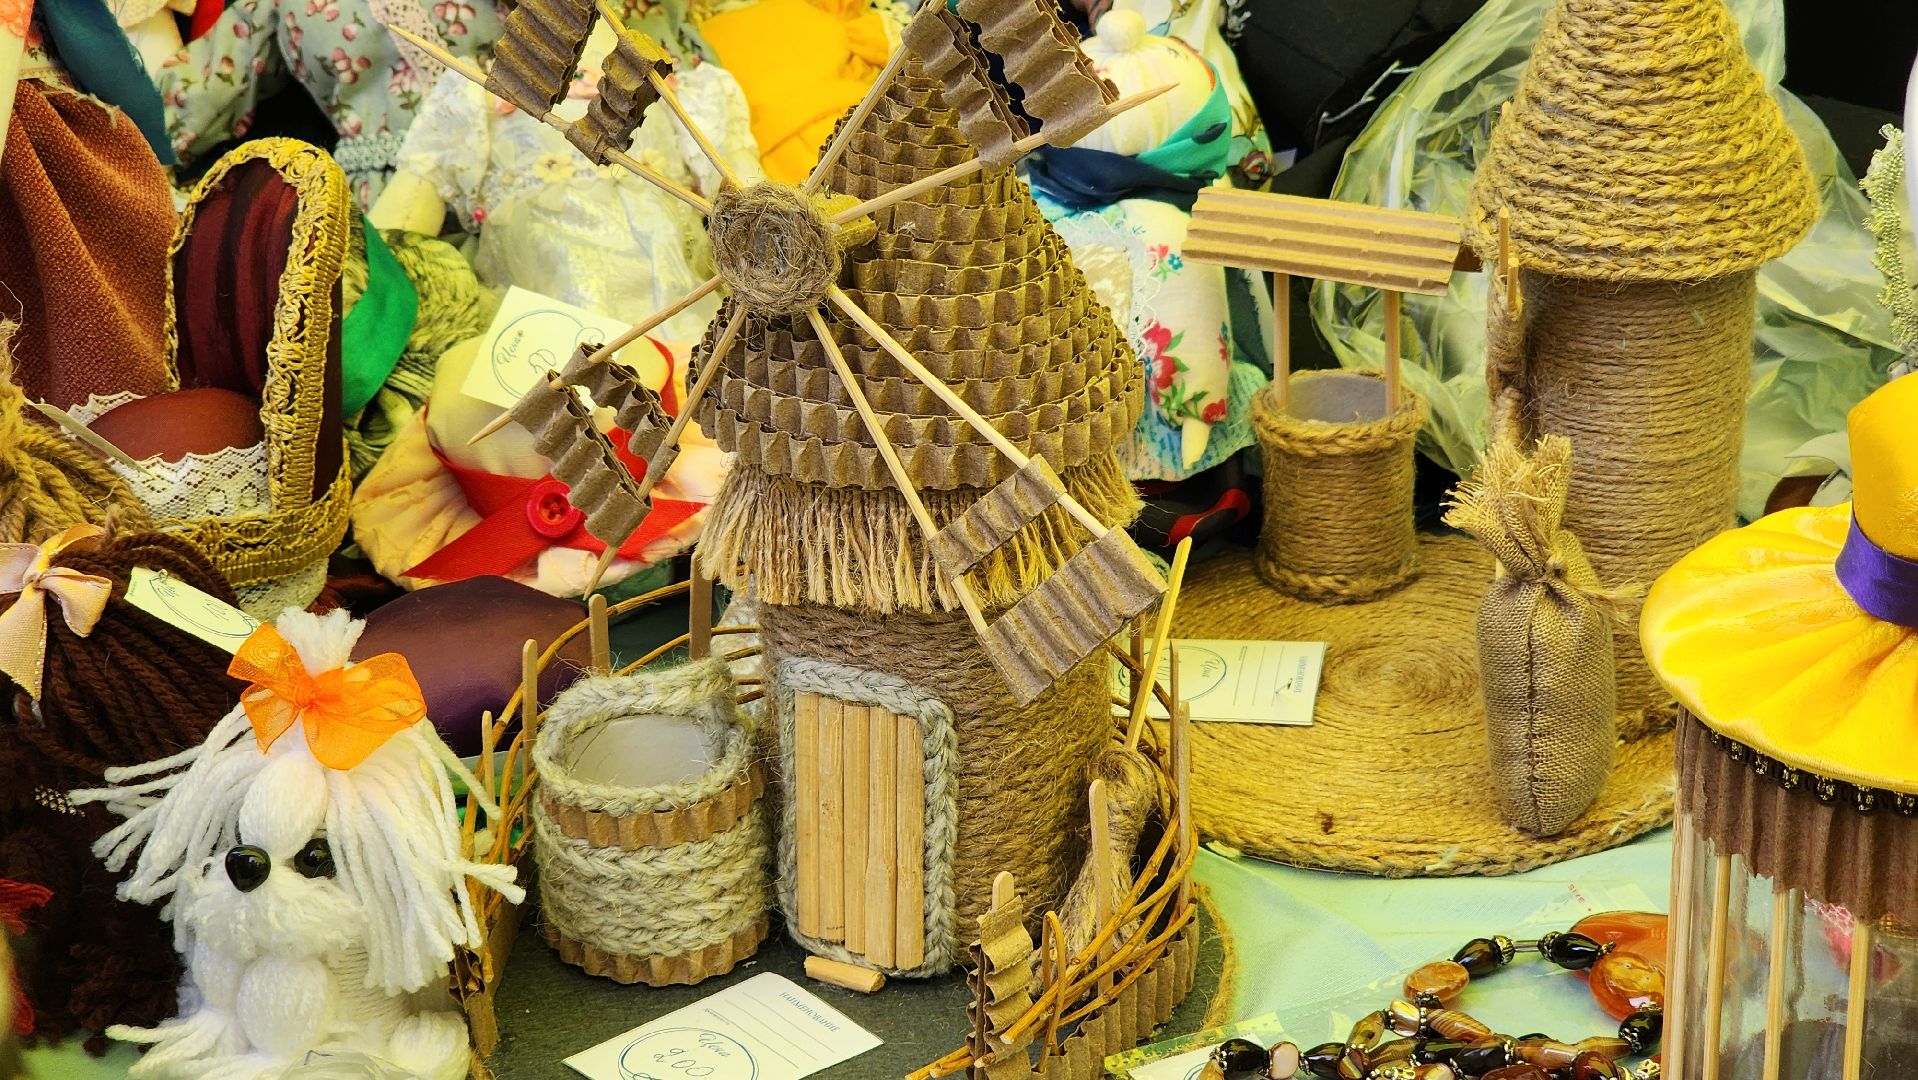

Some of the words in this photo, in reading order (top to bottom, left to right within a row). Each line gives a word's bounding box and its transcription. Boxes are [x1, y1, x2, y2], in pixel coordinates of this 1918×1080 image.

[496, 337, 522, 365] Цена
[778, 991, 841, 1034] НАИМЕНОВАНИЕ
[698, 1033, 732, 1058] Цена
